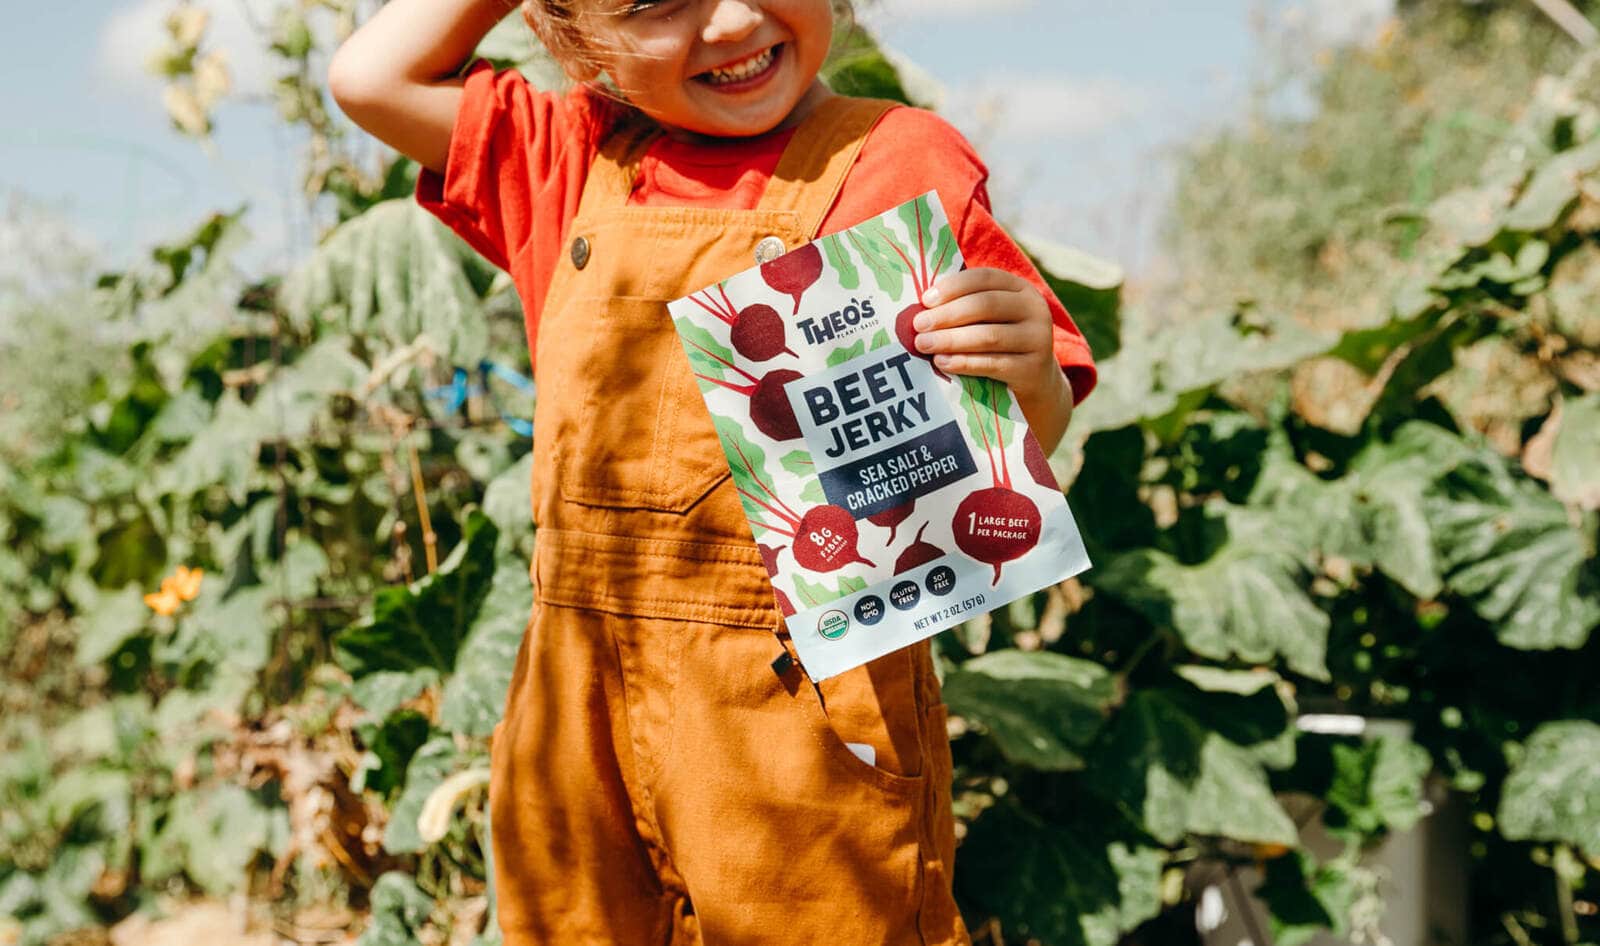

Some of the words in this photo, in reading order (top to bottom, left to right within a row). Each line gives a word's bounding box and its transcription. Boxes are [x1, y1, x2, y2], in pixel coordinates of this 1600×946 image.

[796, 297, 876, 345] THEO'S
[803, 352, 914, 426] BEET
[825, 391, 930, 458] JERKY
[859, 463, 887, 485] SEA
[887, 449, 920, 475] SALT
[921, 445, 933, 462] &
[846, 475, 909, 510] CRACKED
[910, 455, 959, 488] PEPPER
[968, 511, 976, 535] 1
[978, 516, 1006, 526] LARGE
[1008, 518, 1029, 528] BEET
[810, 527, 832, 546] 8G
[977, 528, 990, 537] PER
[993, 529, 1027, 540] PACKAGE
[820, 534, 844, 558] FIBER
[933, 571, 946, 583] SOY
[934, 579, 950, 591] FREE
[891, 584, 917, 600] GLUTEN
[898, 593, 915, 605] FREE
[860, 600, 876, 611] NON
[863, 608, 879, 619] GMO
[823, 615, 841, 626] USDA
[914, 617, 930, 630] NET
[930, 610, 943, 624] WT
[943, 608, 950, 619] 2
